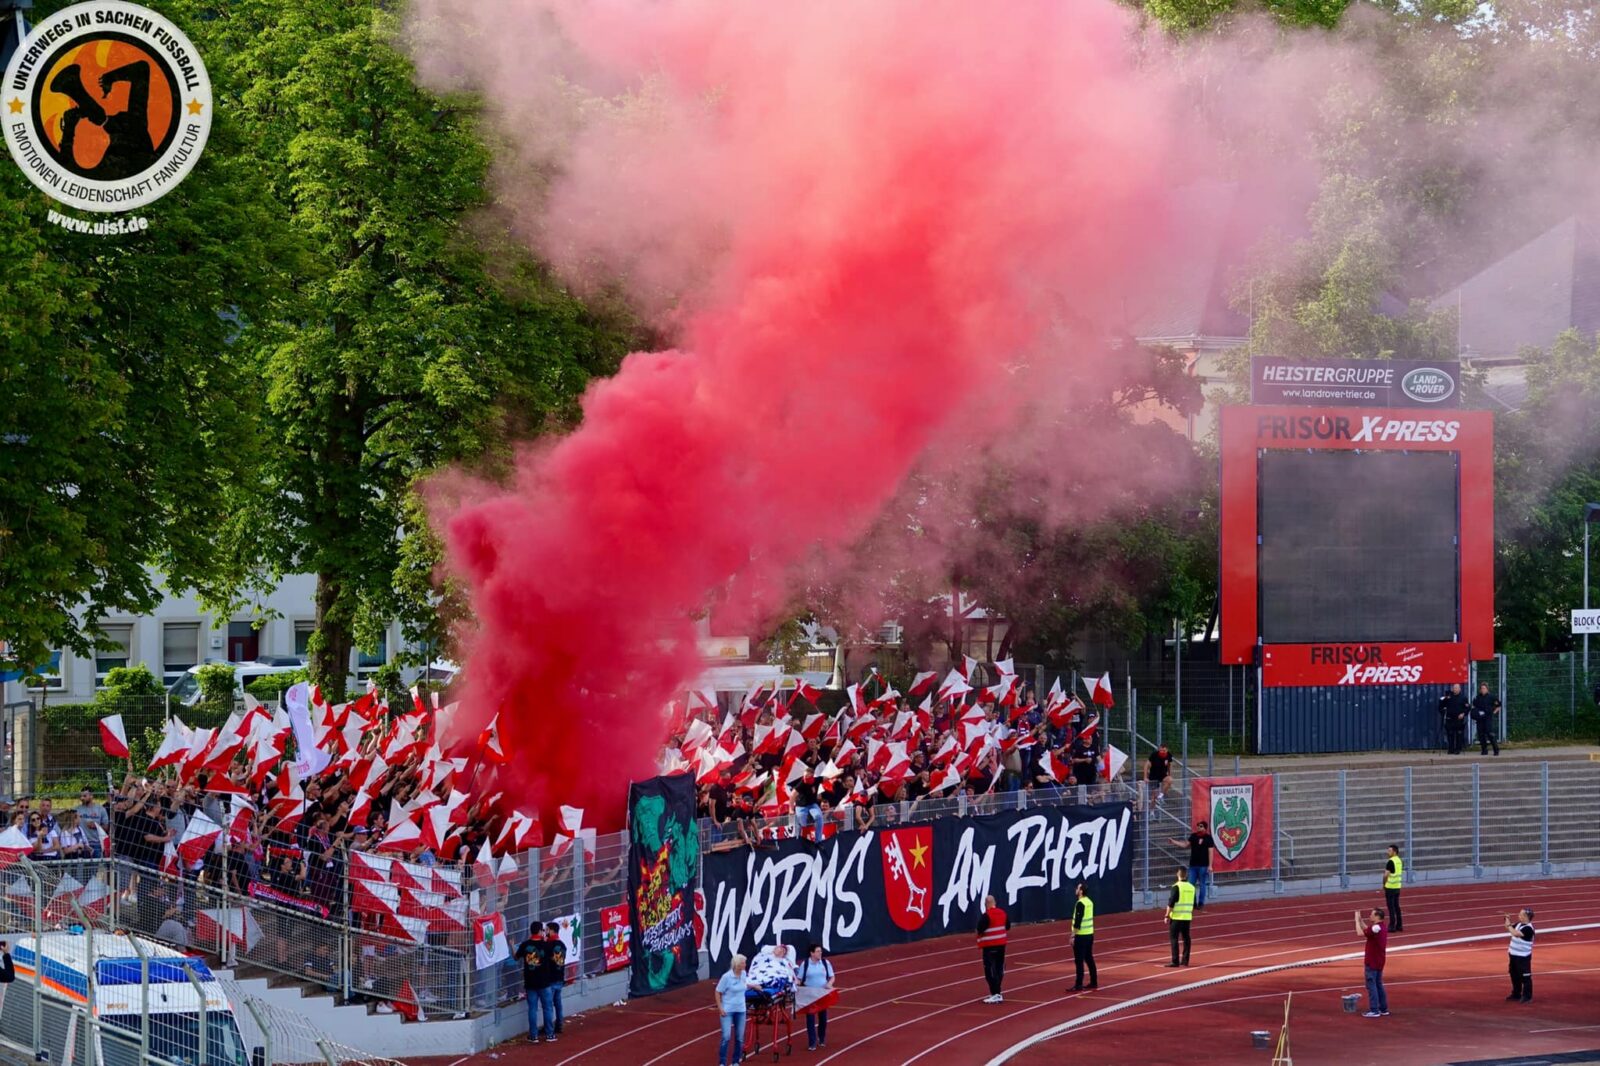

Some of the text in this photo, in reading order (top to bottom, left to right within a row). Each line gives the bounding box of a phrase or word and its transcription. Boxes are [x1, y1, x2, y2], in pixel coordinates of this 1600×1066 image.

[1263, 366, 1394, 384] HEISTERGRUPPE
[1413, 374, 1438, 385] LAND
[1282, 388, 1376, 400] www.landrover-trier.de
[1414, 384, 1445, 394] ROVER
[1351, 416, 1460, 442] X-PRESS
[1573, 616, 1596, 626] BLOCK
[1338, 664, 1423, 684] X-PRESS
[710, 830, 875, 963] WORMS
[938, 827, 997, 929] AM
[1005, 806, 1132, 906] RHEIN
